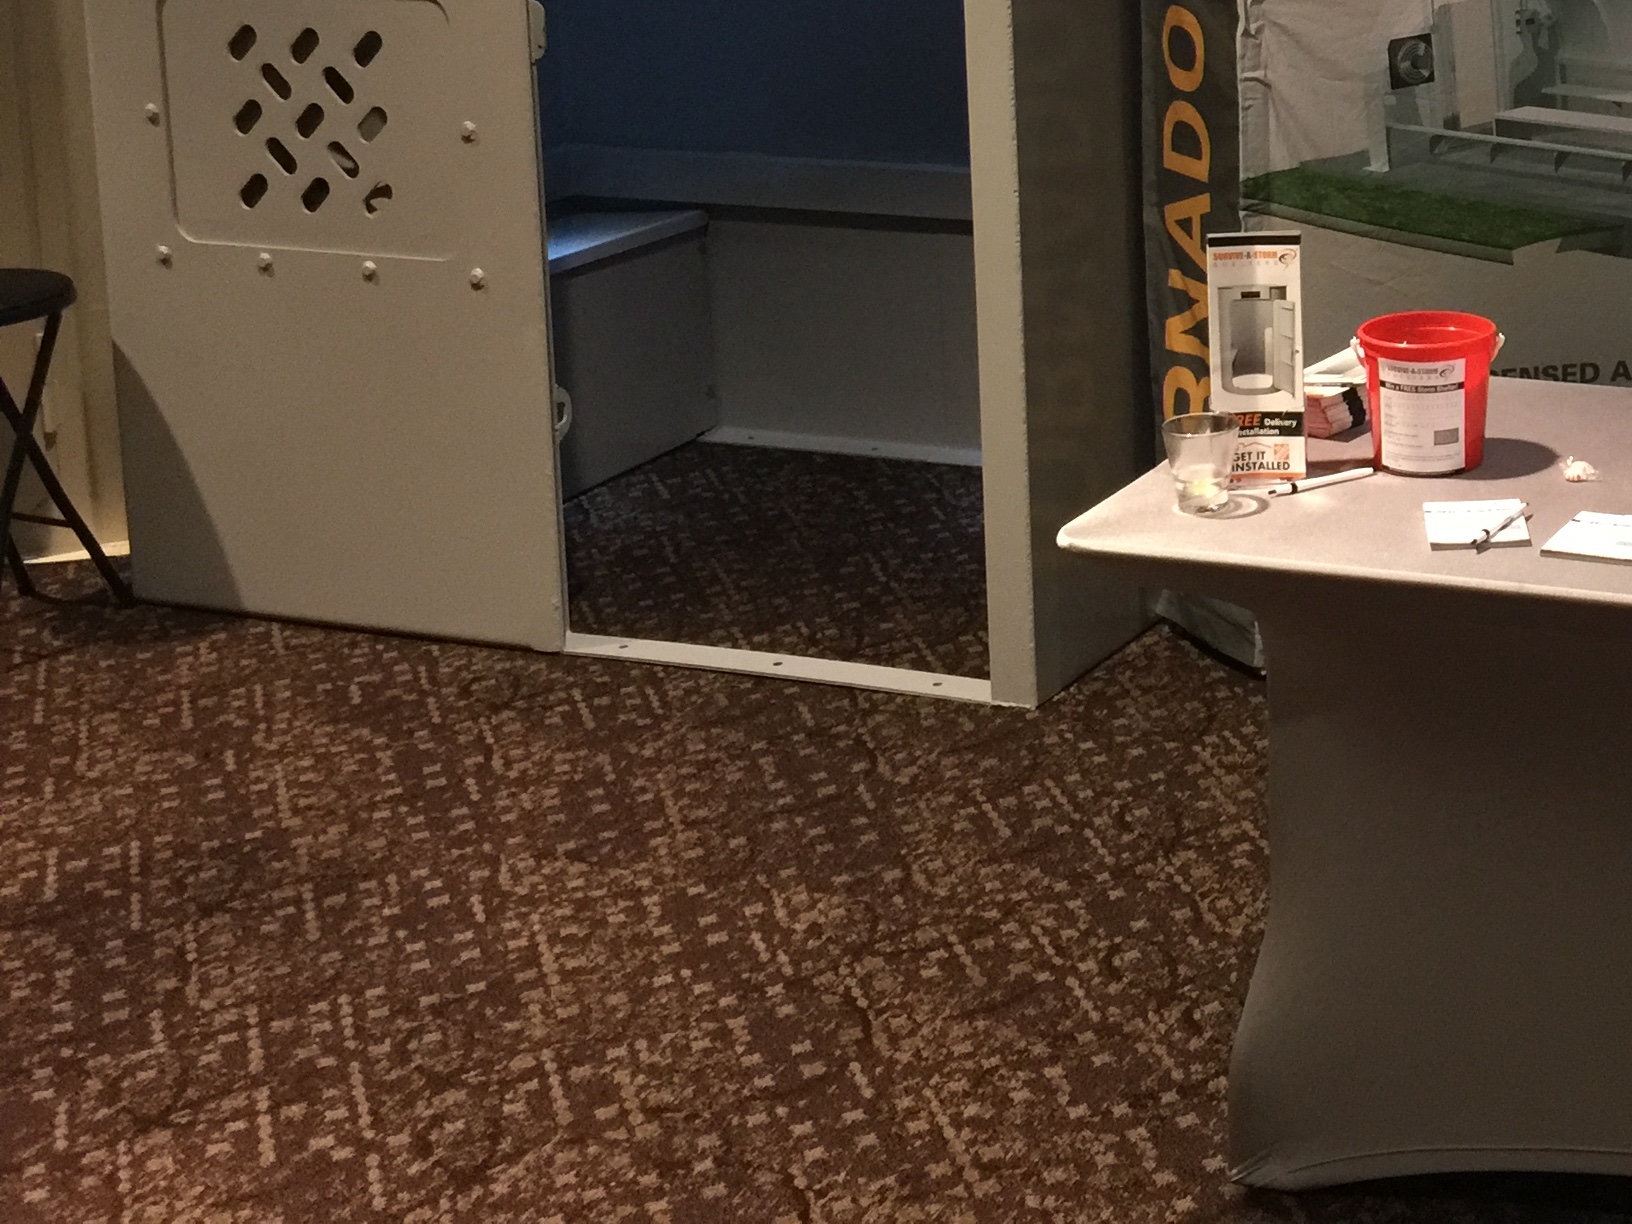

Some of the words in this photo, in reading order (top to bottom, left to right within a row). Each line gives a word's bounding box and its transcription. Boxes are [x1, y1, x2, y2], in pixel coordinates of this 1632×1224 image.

[1232, 413, 1262, 426] REE
[1263, 418, 1298, 428] Delivery
[1237, 427, 1280, 436] nstallation
[1256, 451, 1266, 460] IT
[1231, 462, 1291, 472] INSTALLED
